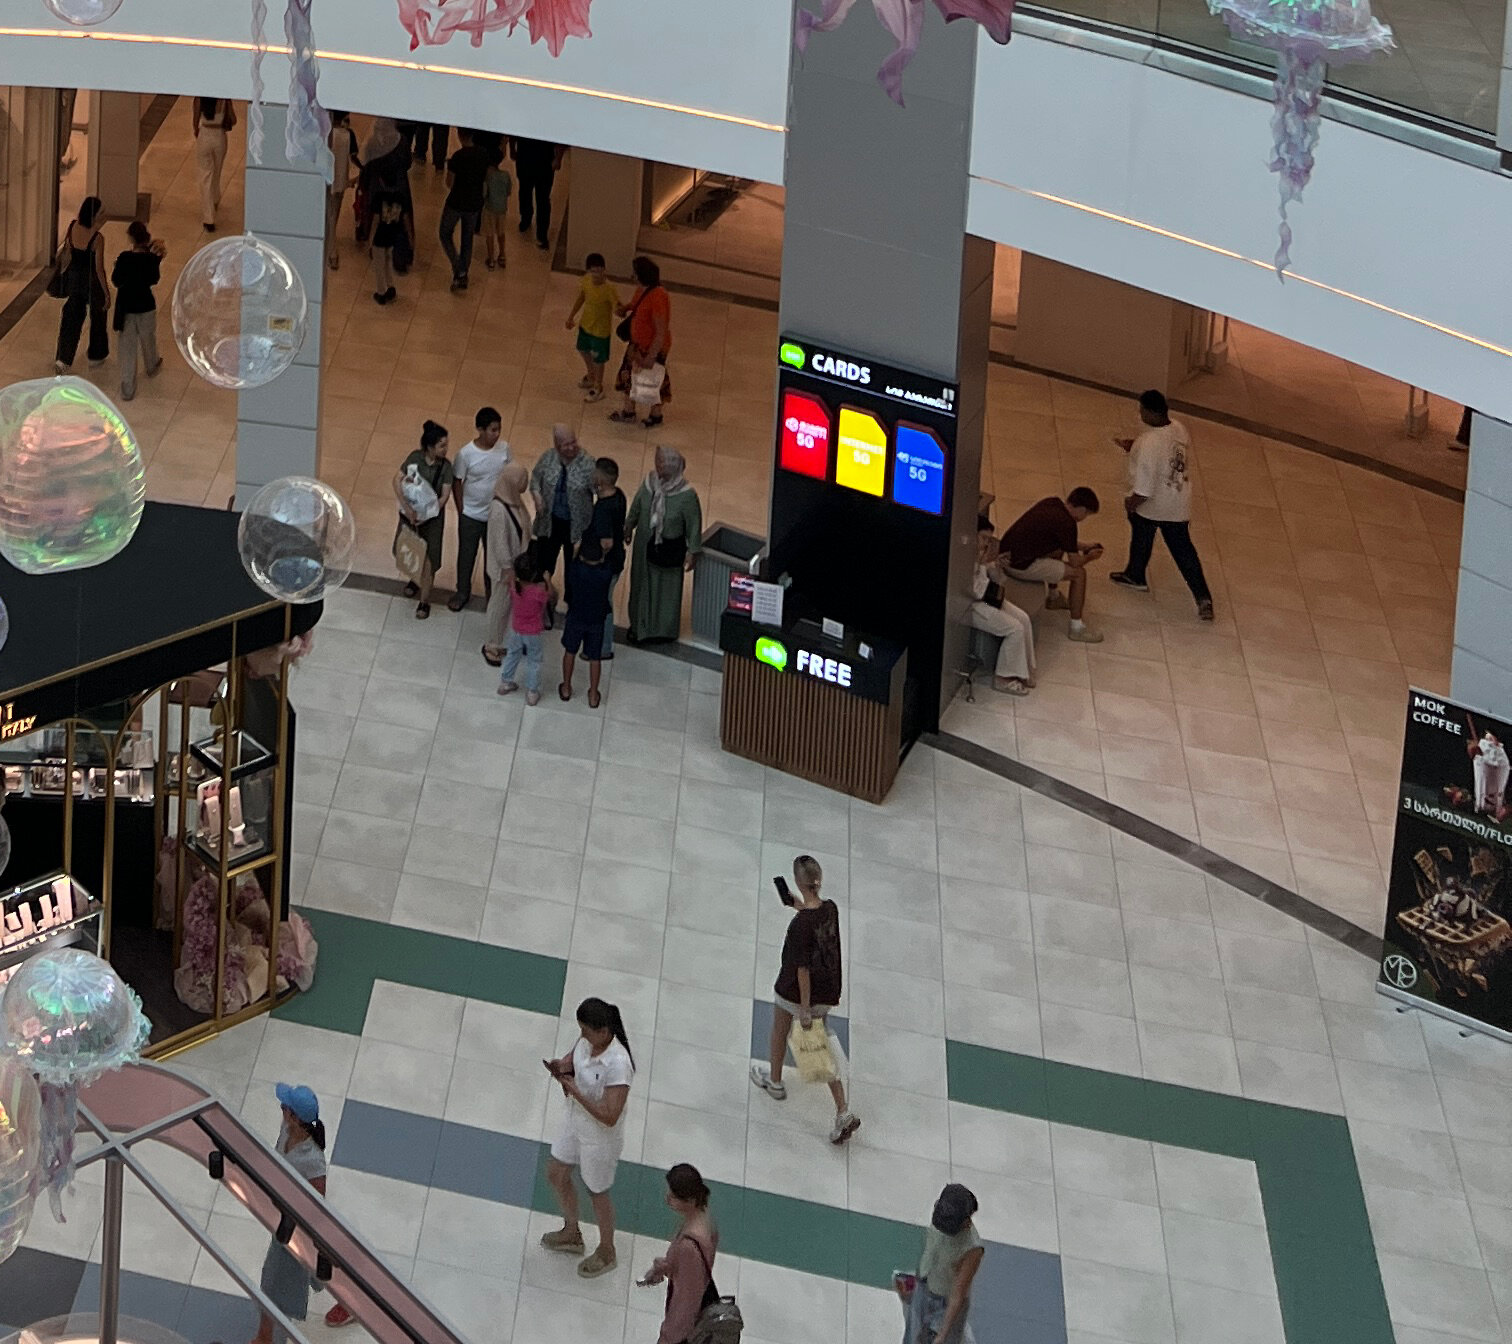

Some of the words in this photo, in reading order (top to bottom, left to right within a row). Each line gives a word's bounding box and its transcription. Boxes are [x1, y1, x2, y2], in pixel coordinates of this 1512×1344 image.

[811, 353, 872, 384] CARDS
[909, 466, 927, 482] 5G
[796, 649, 852, 687] FREE
[1414, 696, 1446, 715] MOK
[1412, 711, 1463, 736] COFFEE
[1403, 797, 1412, 810] 3
